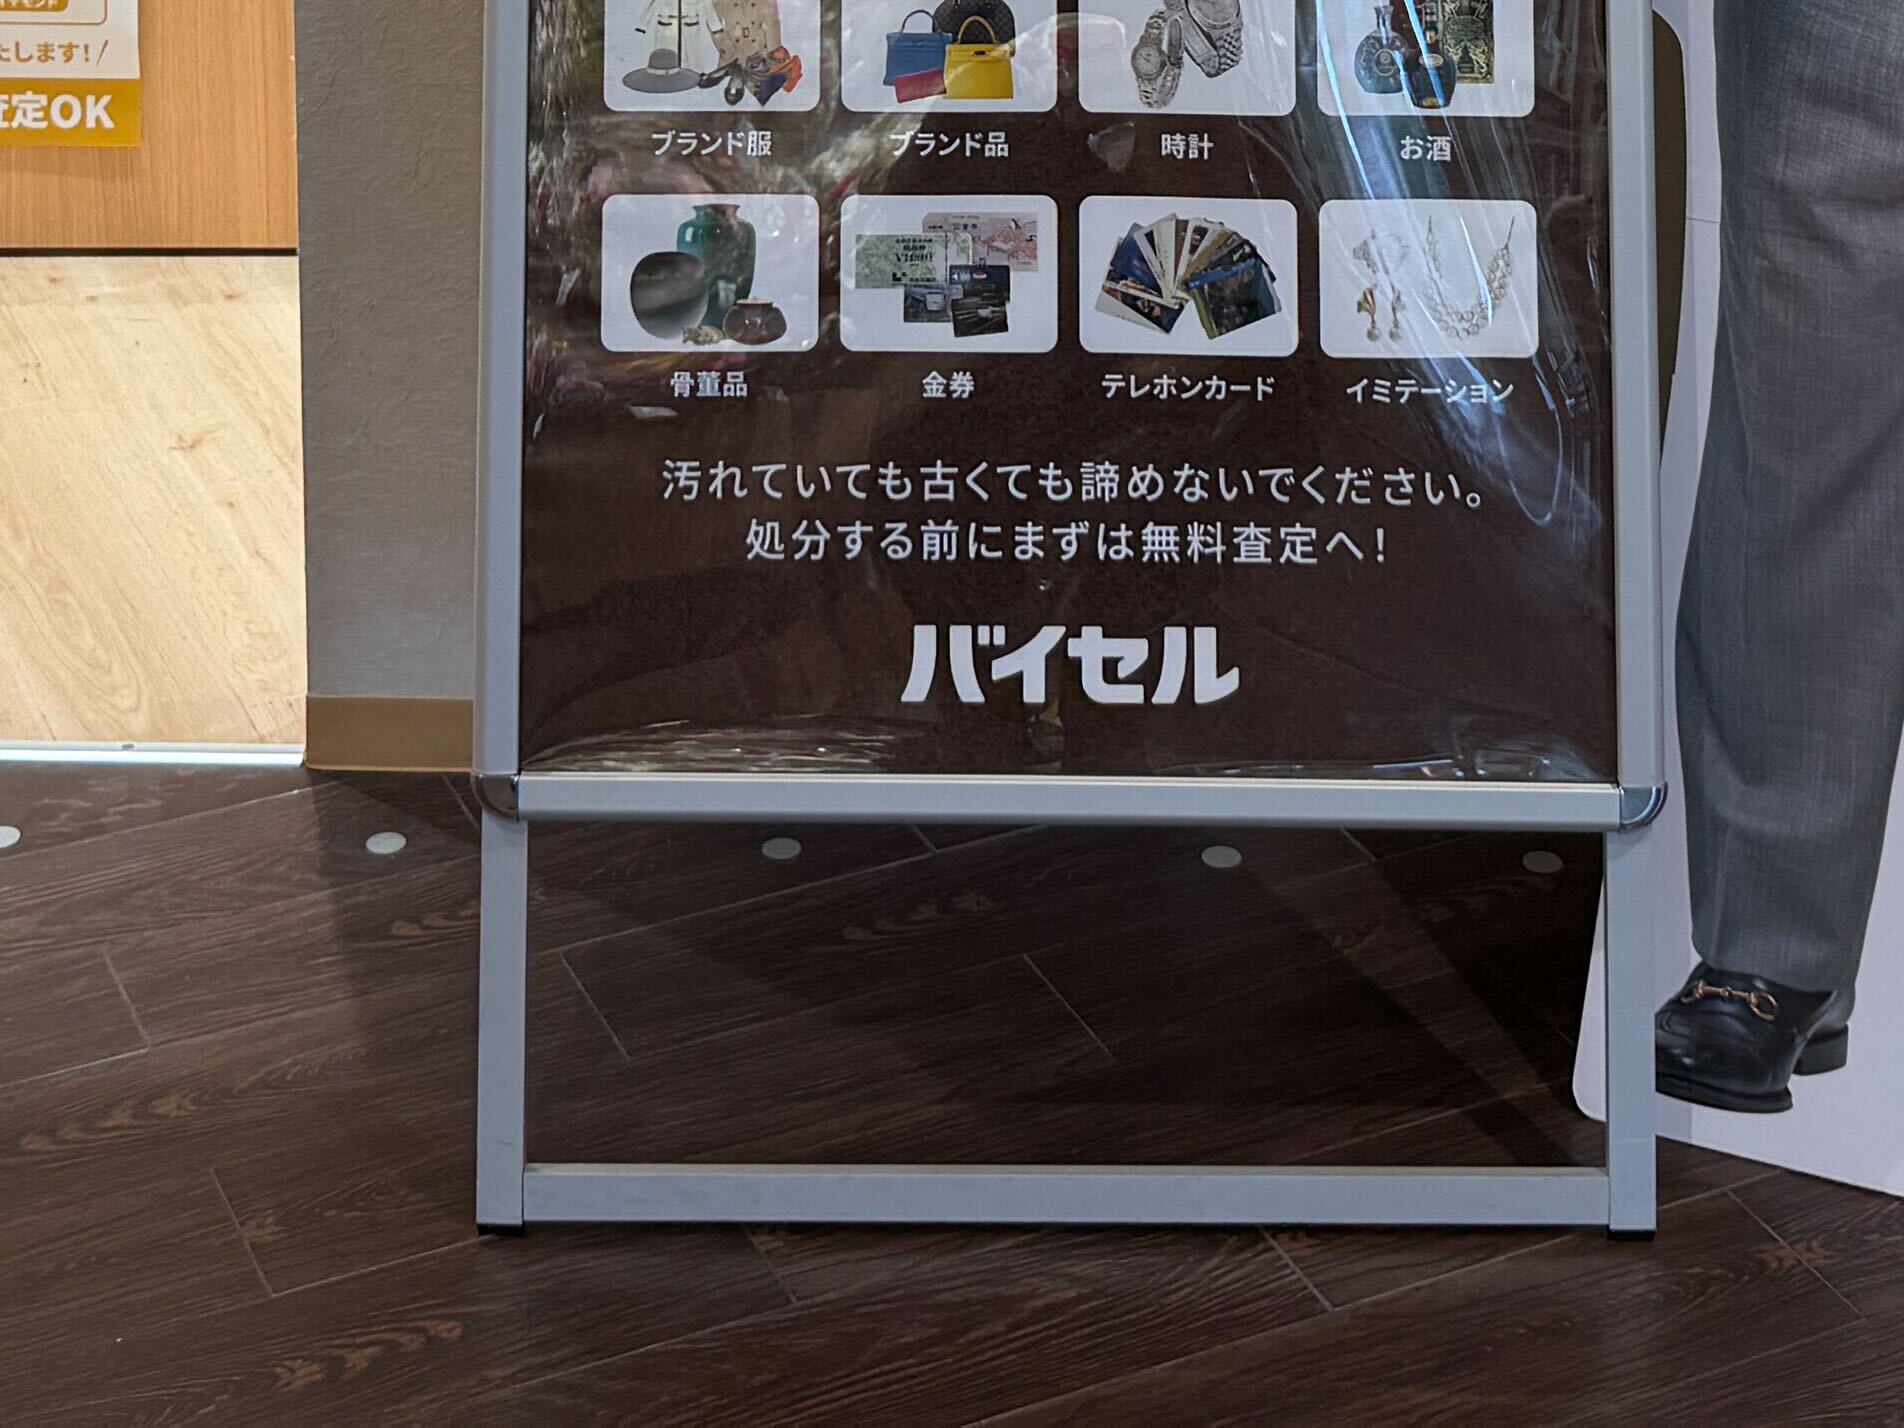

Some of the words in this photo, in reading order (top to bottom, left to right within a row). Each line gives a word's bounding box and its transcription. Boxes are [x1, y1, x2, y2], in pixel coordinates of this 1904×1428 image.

[651, 130, 774, 158] ブランド服
[889, 131, 1010, 159] ブランド品
[1160, 132, 1214, 161] 時計
[1398, 134, 1452, 163] お酒
[670, 370, 748, 399] 骨董品
[921, 372, 976, 401] 金券
[1100, 374, 1276, 403] テレホンカード
[1345, 377, 1514, 406] イミテーション
[661, 459, 1486, 507] 汚れていても古くても諦めないでください。
[745, 520, 1387, 566] 処分する前にまずは無料査定へ!
[900, 622, 1240, 706] バイセル
